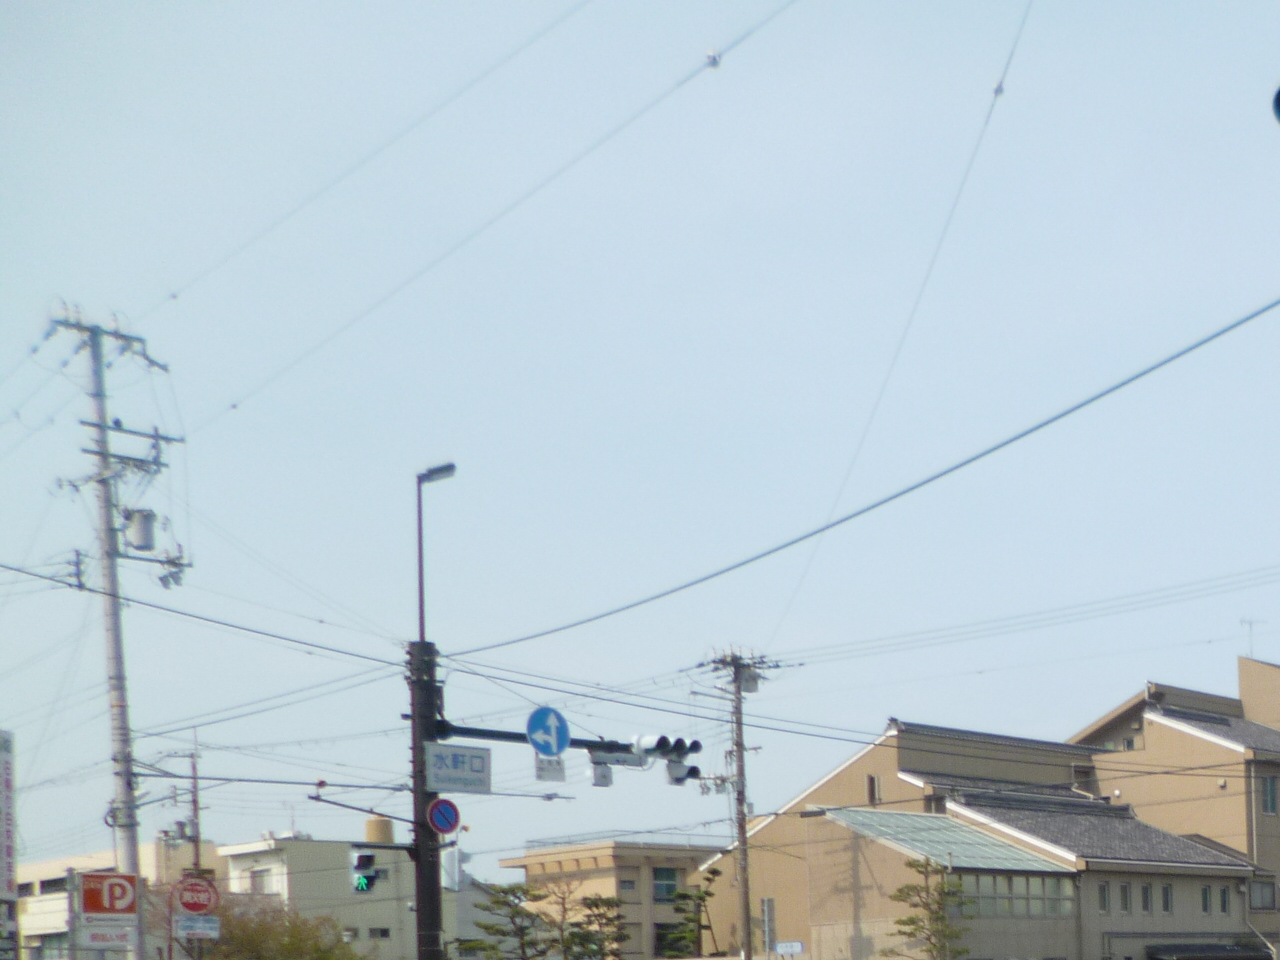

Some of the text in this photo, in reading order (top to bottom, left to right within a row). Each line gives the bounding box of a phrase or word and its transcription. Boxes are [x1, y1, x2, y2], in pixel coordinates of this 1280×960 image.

[433, 752, 485, 773] 水軒口
[102, 877, 135, 911] P
